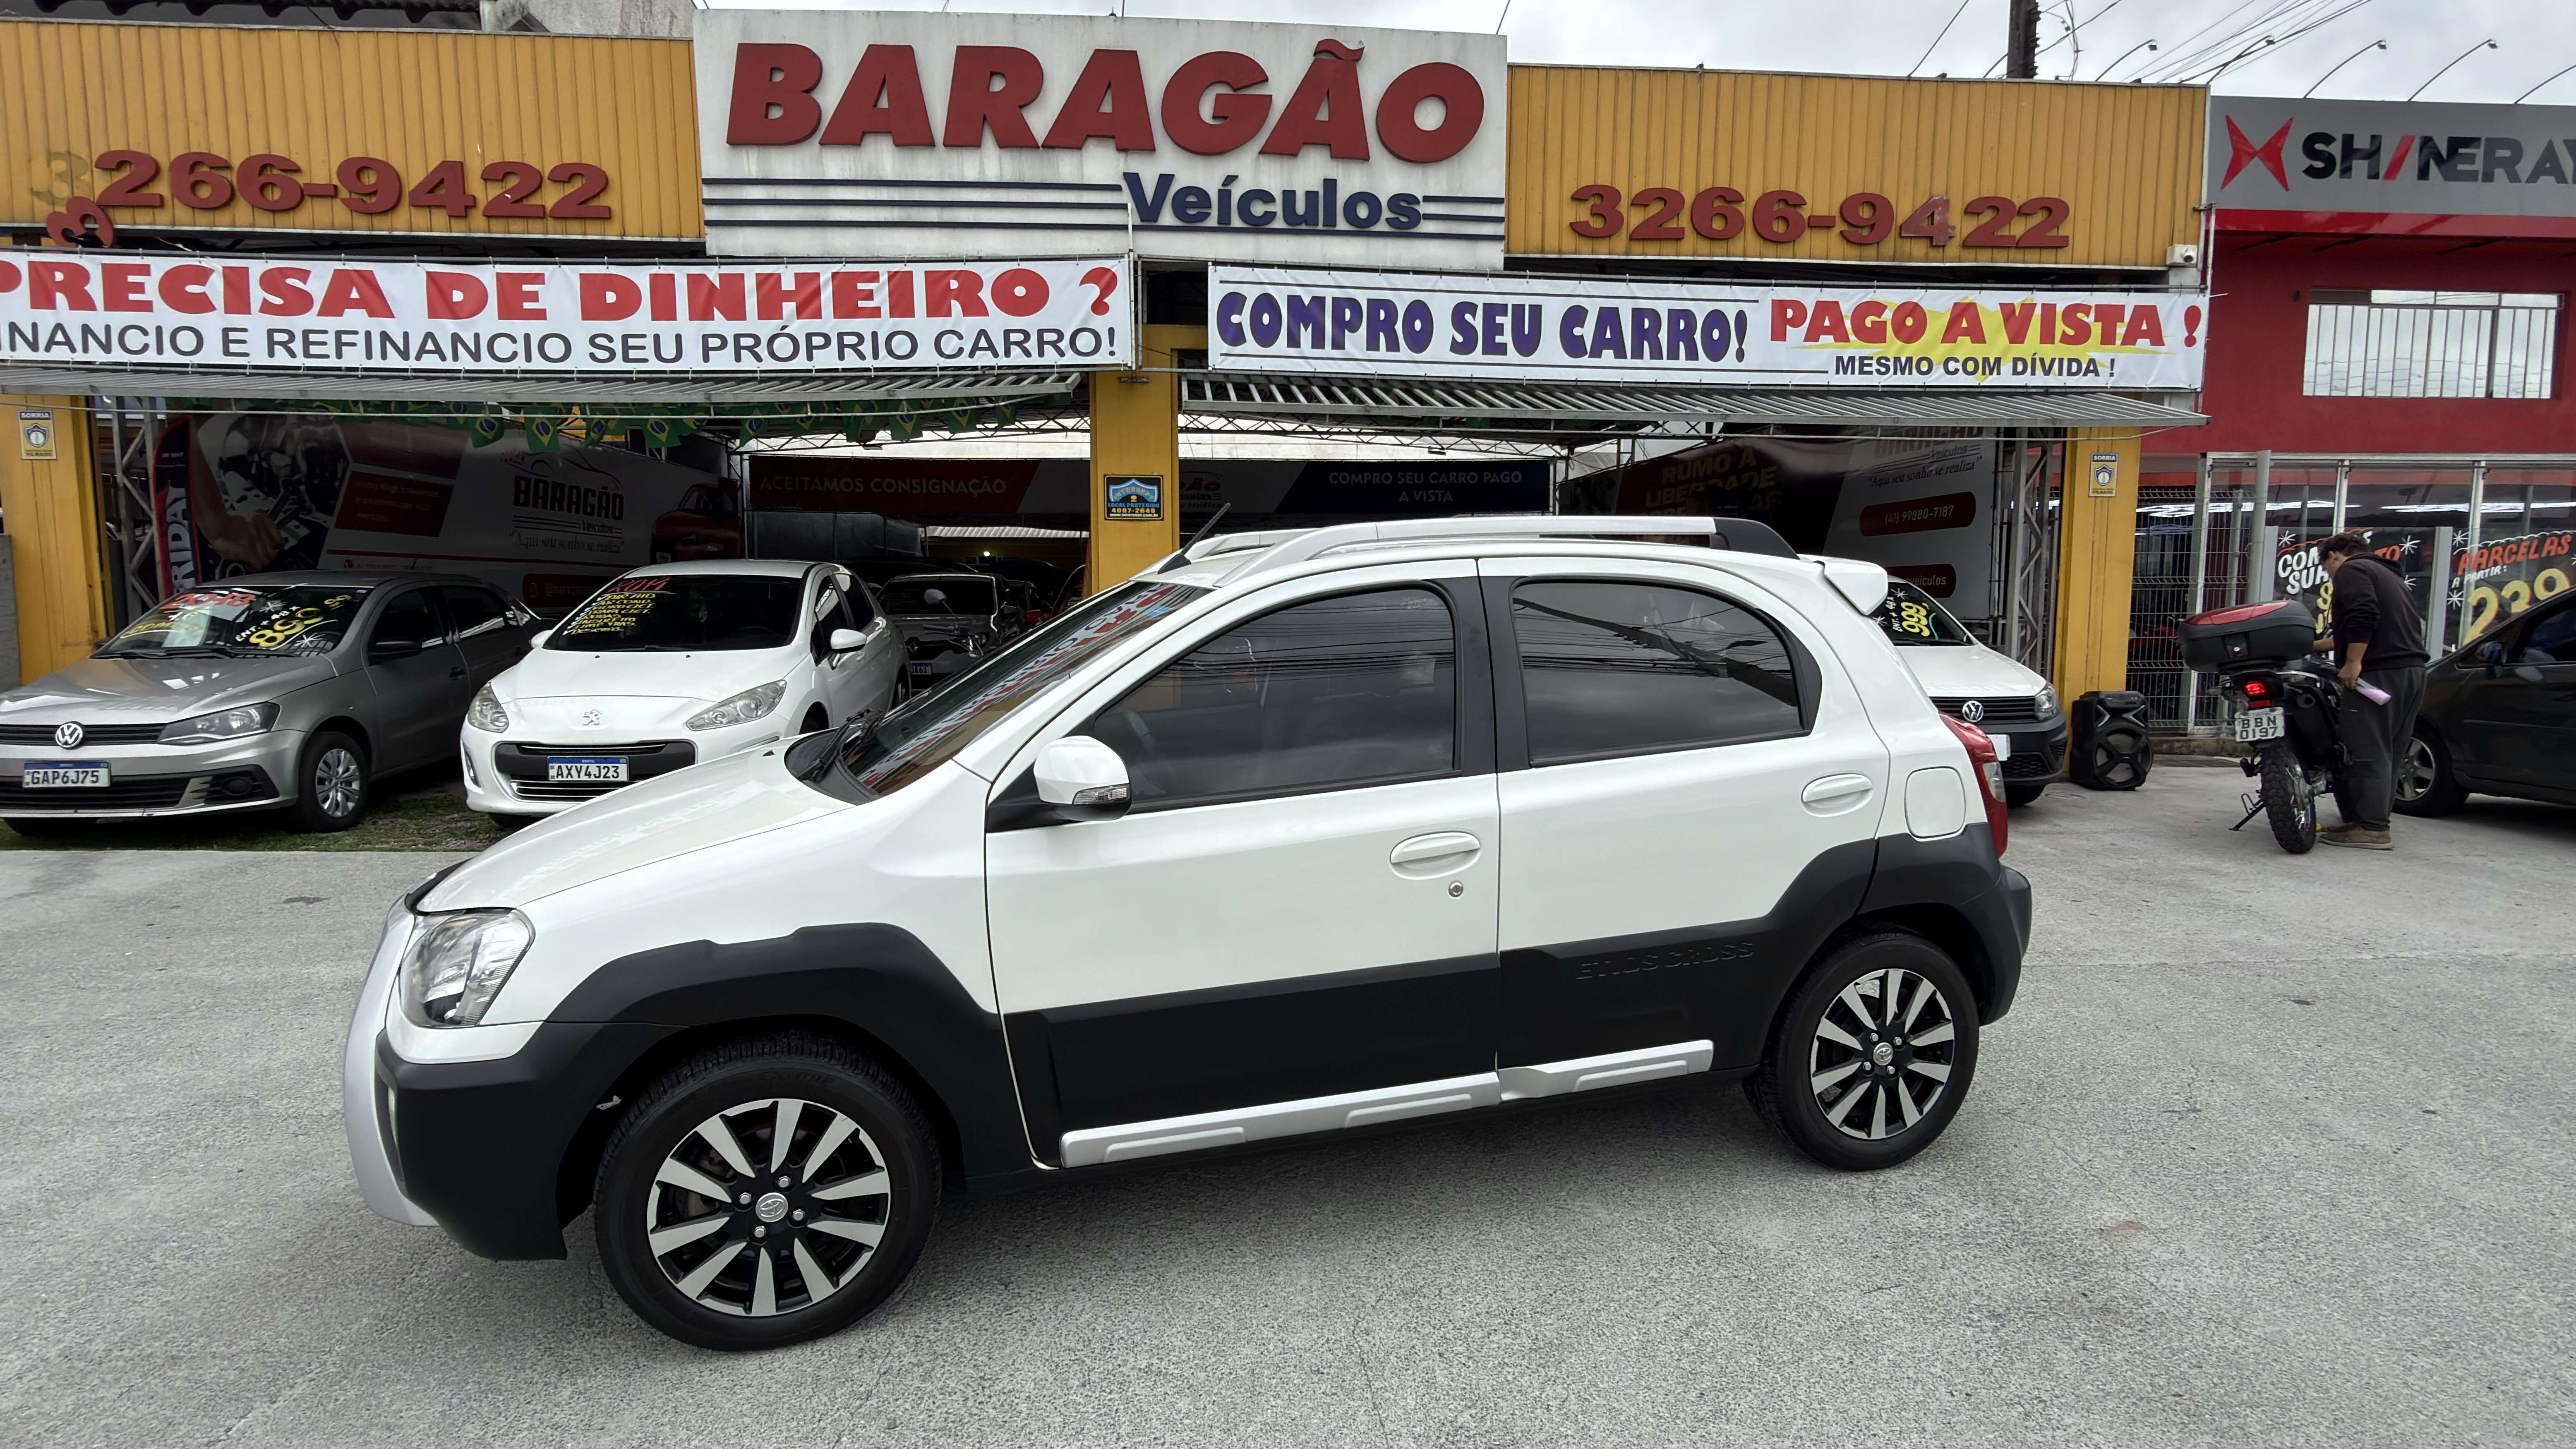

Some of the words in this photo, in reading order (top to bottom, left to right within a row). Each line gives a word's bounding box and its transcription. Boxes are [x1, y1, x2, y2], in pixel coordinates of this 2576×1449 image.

[727, 38, 1485, 163] BARAGÃO
[1123, 172, 1424, 230] Veículos
[1569, 184, 2070, 248] 3266-9422
[426, 271, 547, 321] DE
[579, 268, 1050, 321] DINHEIRO
[1079, 267, 1118, 316] ?
[1216, 292, 1434, 355] COMPRO
[1449, 301, 1542, 357] SEU
[1559, 304, 1748, 363] CARRO!
[1770, 299, 1928, 345] PAGO
[1940, 302, 1986, 345] A
[1997, 302, 2166, 347] VISTA
[2184, 305, 2202, 348] !
[0, 321, 204, 357] NANCIO
[222, 327, 250, 357] E
[266, 328, 581, 364] REFINANCIO
[588, 333, 684, 364] SEU
[701, 324, 919, 364] PRÓPRIO
[933, 326, 1116, 359] CARRO!
[1835, 355, 1935, 376] MESMO
[1943, 356, 2006, 376] COM
[2011, 352, 2100, 377] DÍVIDA
[1329, 472, 1393, 485] COMPRO
[1397, 472, 1425, 485] SEU
[1429, 472, 1478, 485] CARRO
[1483, 471, 1522, 484] PAGO
[1662, 453, 1732, 484] RUMO
[513, 475, 624, 521] BARAGÃO
[760, 476, 863, 493] ACEITAMOS
[870, 476, 1007, 497] CONSIGNAÇÃO
[1398, 490, 1408, 503] A
[1411, 490, 1453, 503] VISTA
[1902, 505, 1955, 522] 99880-7187
[2457, 534, 2573, 576] PARCELAS
[2451, 577, 2461, 589] A
[159, 593, 257, 610] 2018
[2240, 726, 2278, 739] 0197
[2241, 715, 2276, 729] BBN
[31, 770, 99, 785] GAP6J75
[556, 765, 619, 779] AXY4J23
